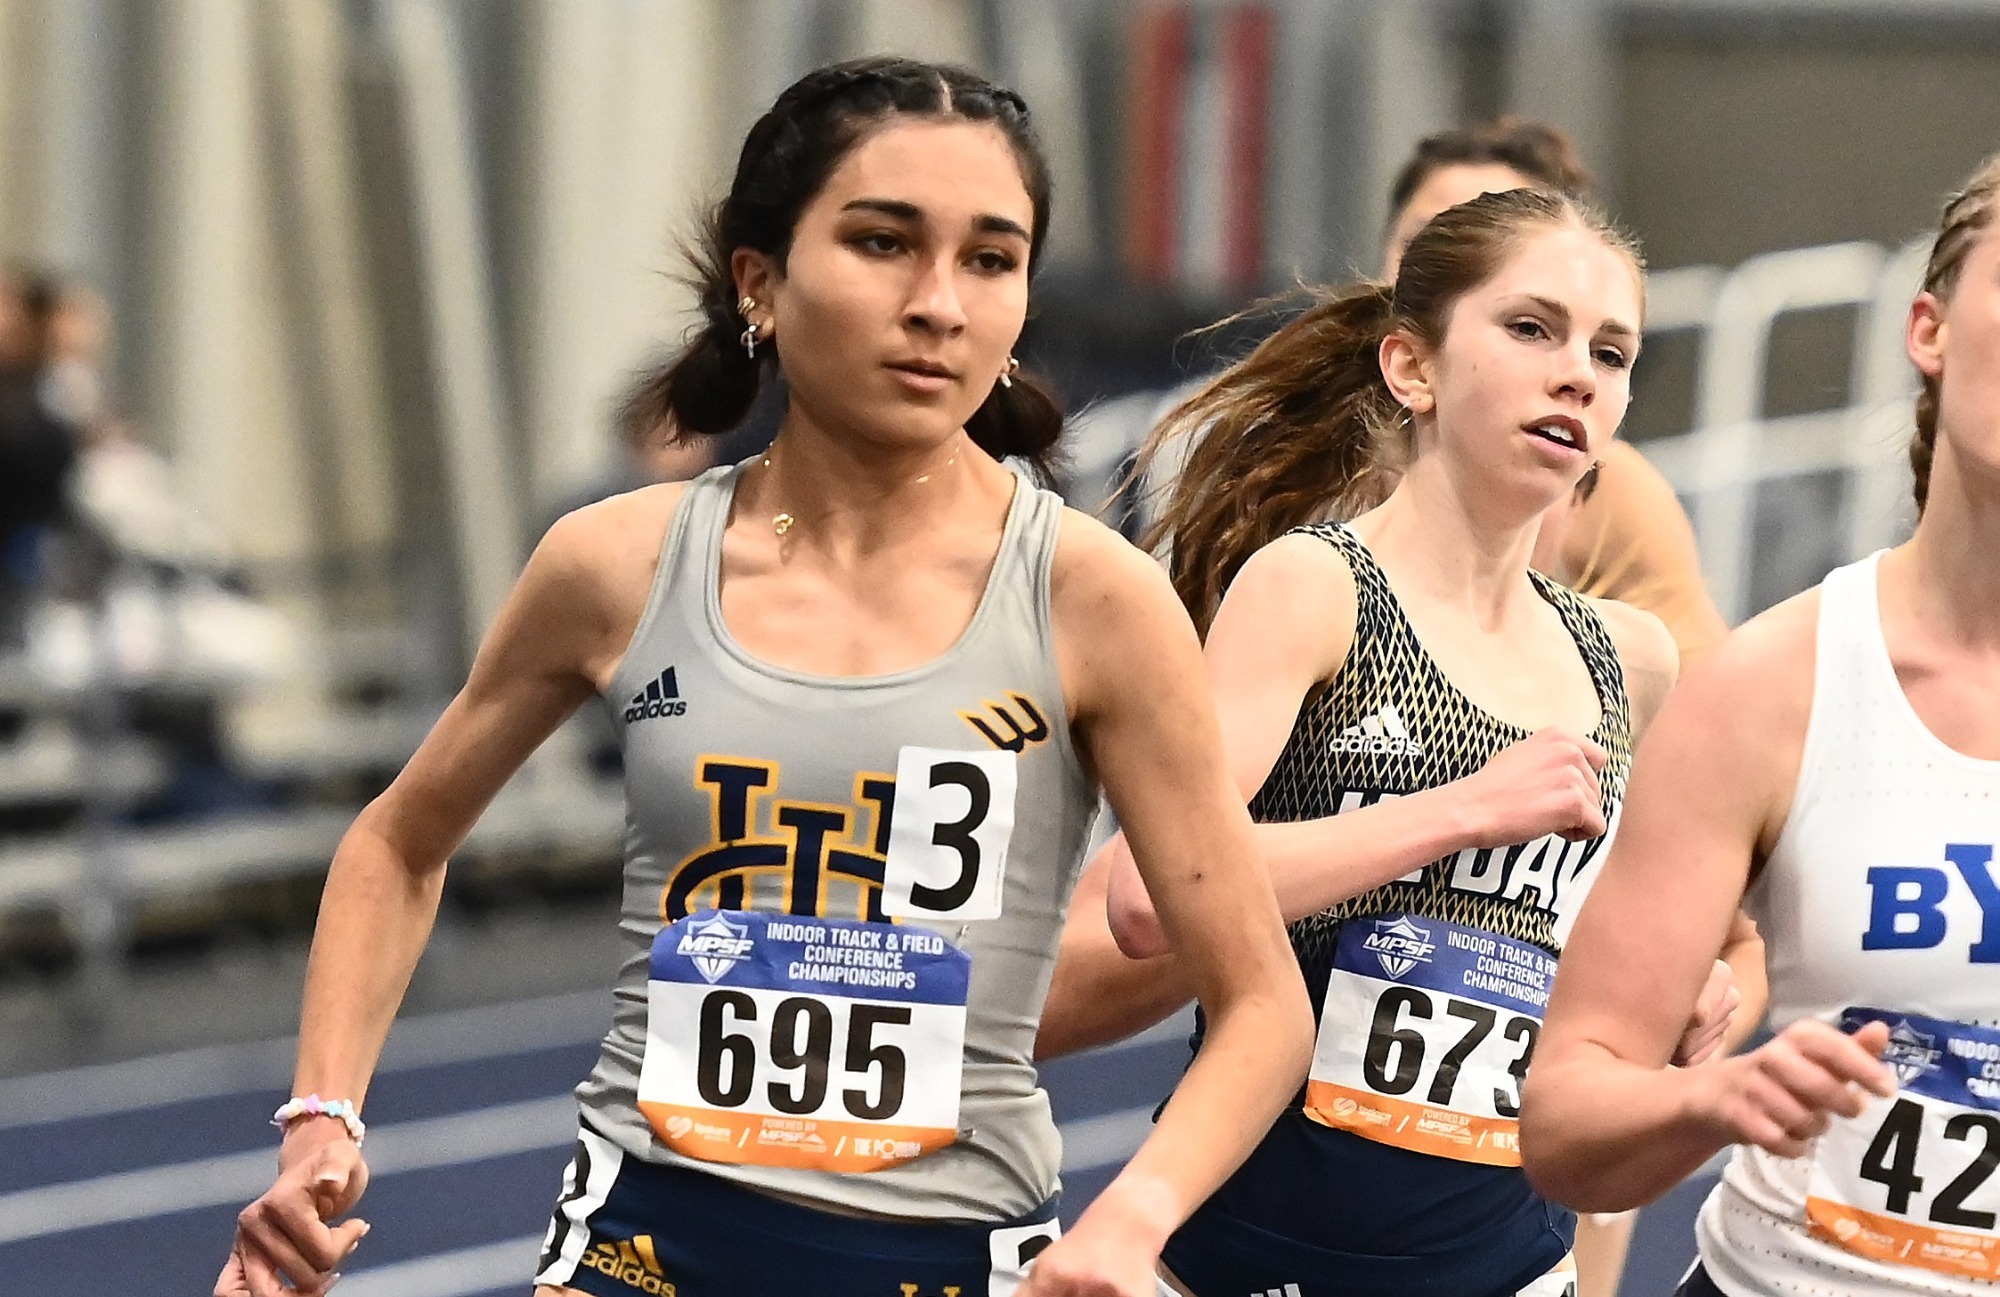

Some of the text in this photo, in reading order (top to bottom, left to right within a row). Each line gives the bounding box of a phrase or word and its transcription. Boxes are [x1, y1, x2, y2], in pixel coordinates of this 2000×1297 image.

[625, 698, 687, 723] adidas
[1329, 735, 1423, 756] adidas
[909, 761, 991, 912] 3
[1450, 832, 1606, 913] DAV
[677, 934, 755, 956] MPSF
[766, 922, 944, 956] INDOOR TRACK & FIELD
[1363, 932, 1436, 957] MPSF
[1447, 930, 1559, 978] INDOOR TRACK & FIE
[804, 944, 904, 970] CONFERENCE
[1477, 955, 1547, 990] CONFERENCE
[788, 961, 916, 990] CHAMPIONSHIPS
[697, 990, 912, 1120] 695
[1363, 986, 1544, 1118] 673
[1859, 1097, 2000, 1231] 42
[580, 1249, 678, 1297] adidas
